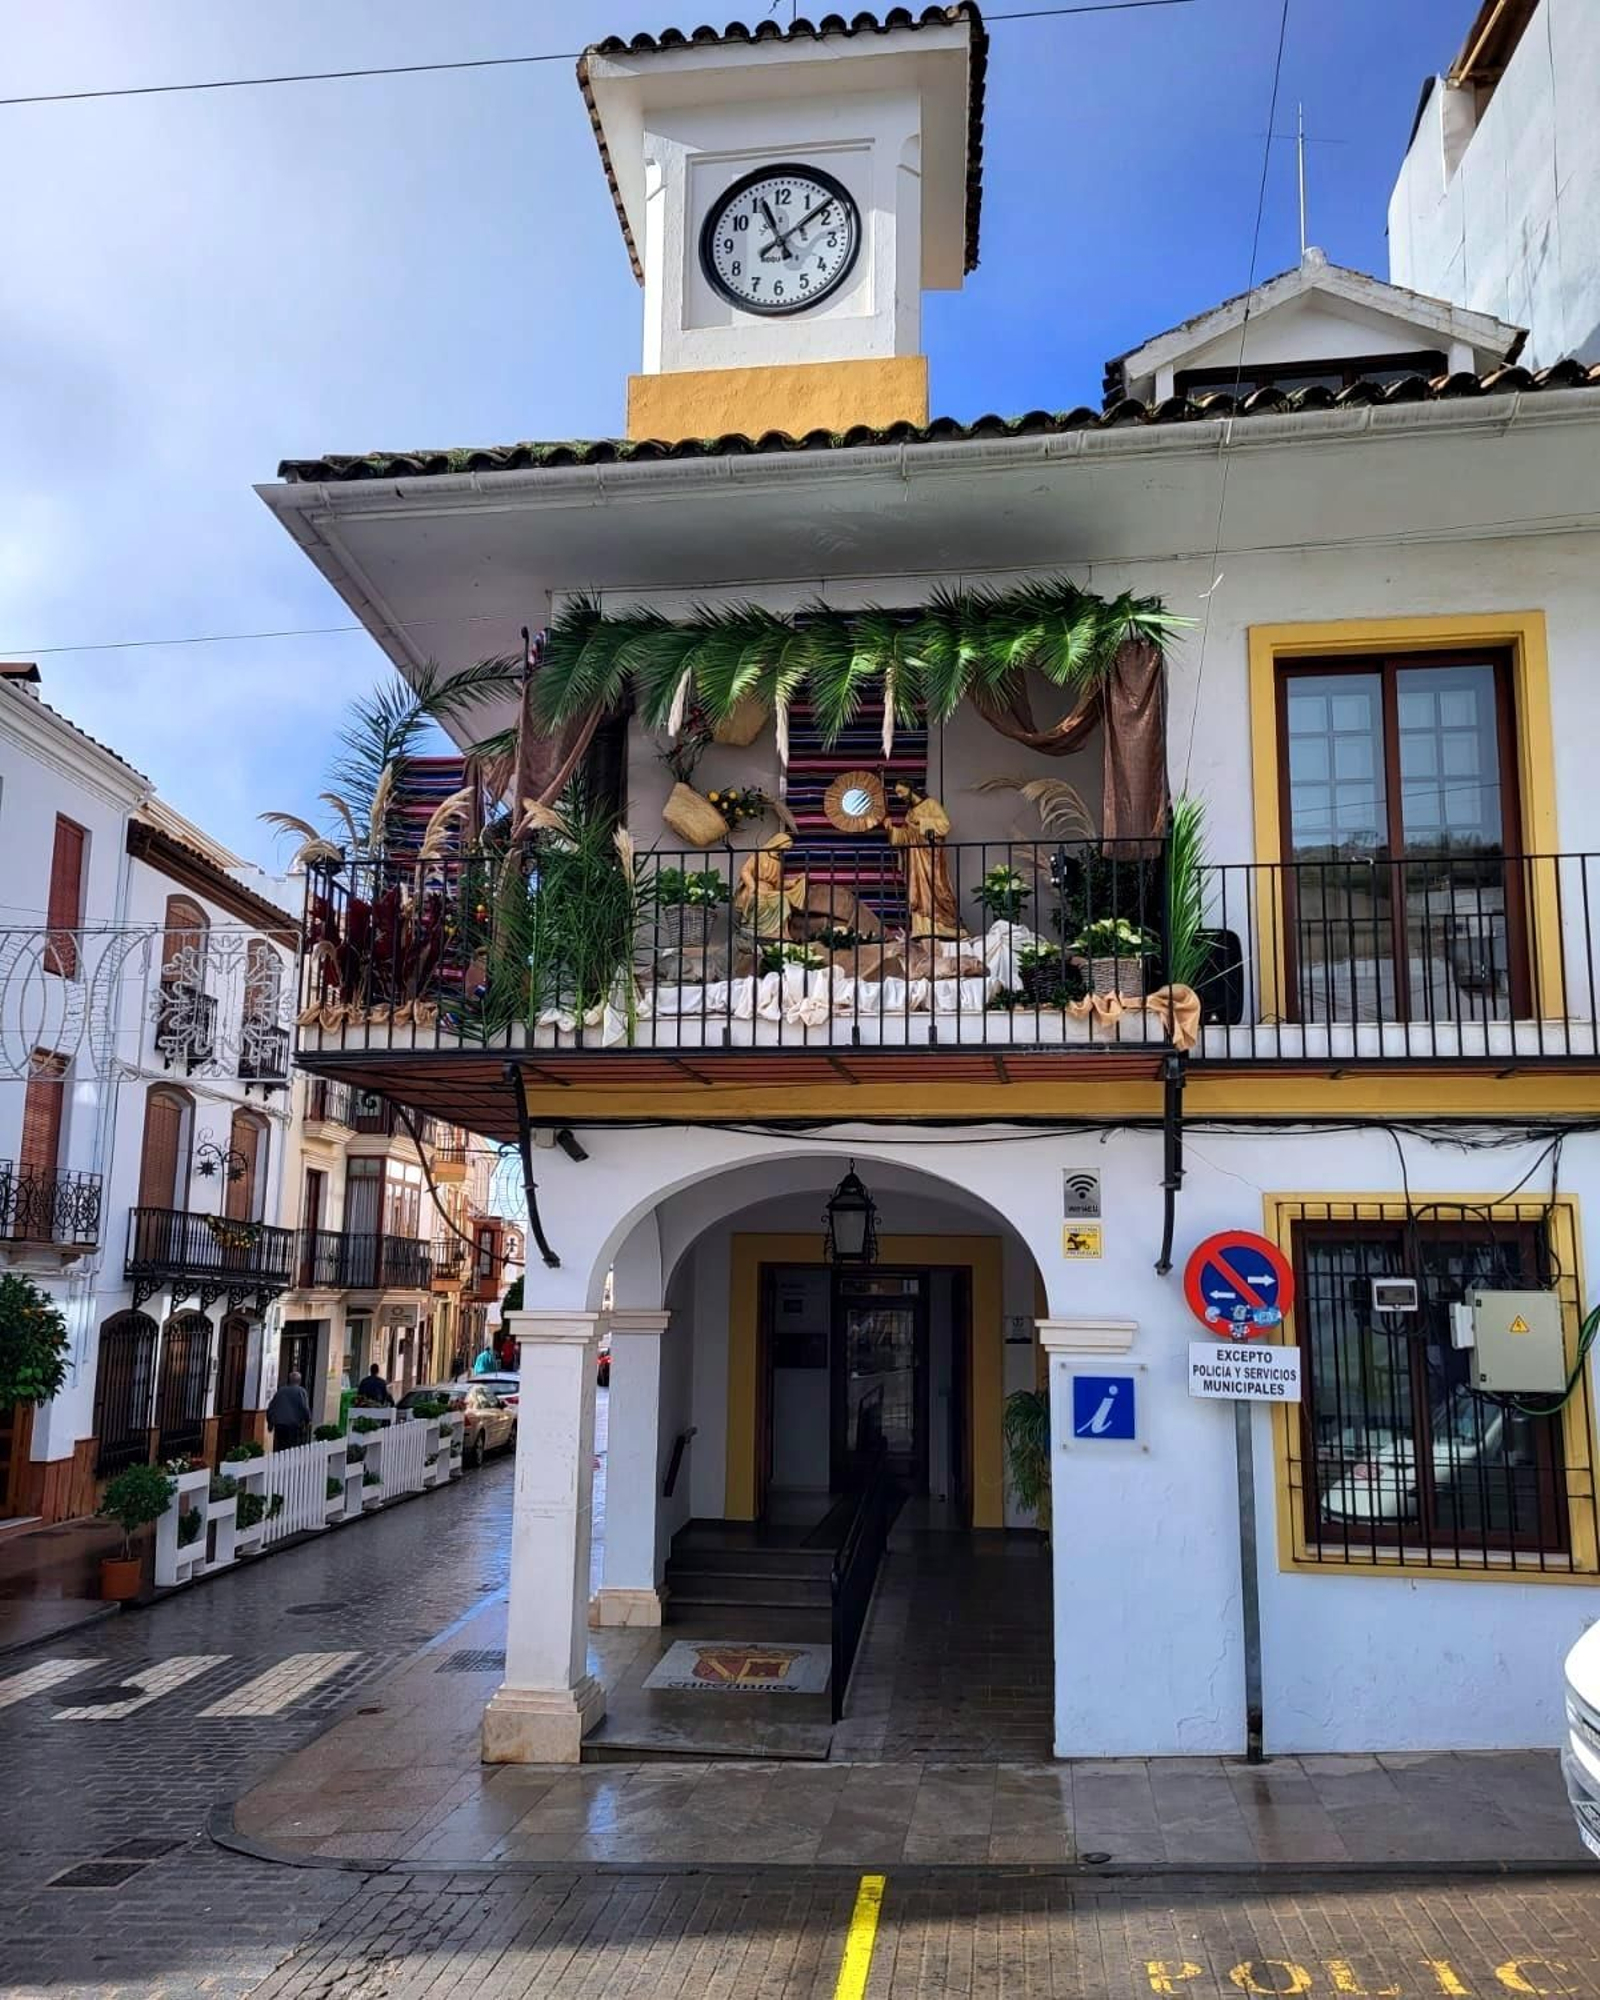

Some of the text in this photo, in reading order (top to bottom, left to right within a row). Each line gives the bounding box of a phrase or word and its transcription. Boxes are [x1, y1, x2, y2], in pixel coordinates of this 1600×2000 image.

[775, 189, 791, 205] 12
[805, 194, 811, 210] 1
[733, 215, 748, 231] 10
[820, 209, 831, 226] 2
[724, 239, 734, 254] 9
[827, 231, 838, 247] 3
[731, 261, 741, 276] 8
[817, 257, 827, 272] 4
[751, 277, 761, 292] 7
[774, 280, 784, 296] 6
[799, 273, 810, 289] 5
[1216, 1349, 1273, 1363] EXCEPTO
[1235, 1367, 1242, 1378] Y
[1244, 1367, 1297, 1381] SERVICIOS
[1203, 1380, 1285, 1395] MUNICIPALES
[1142, 1958, 1600, 1996] POLIC
